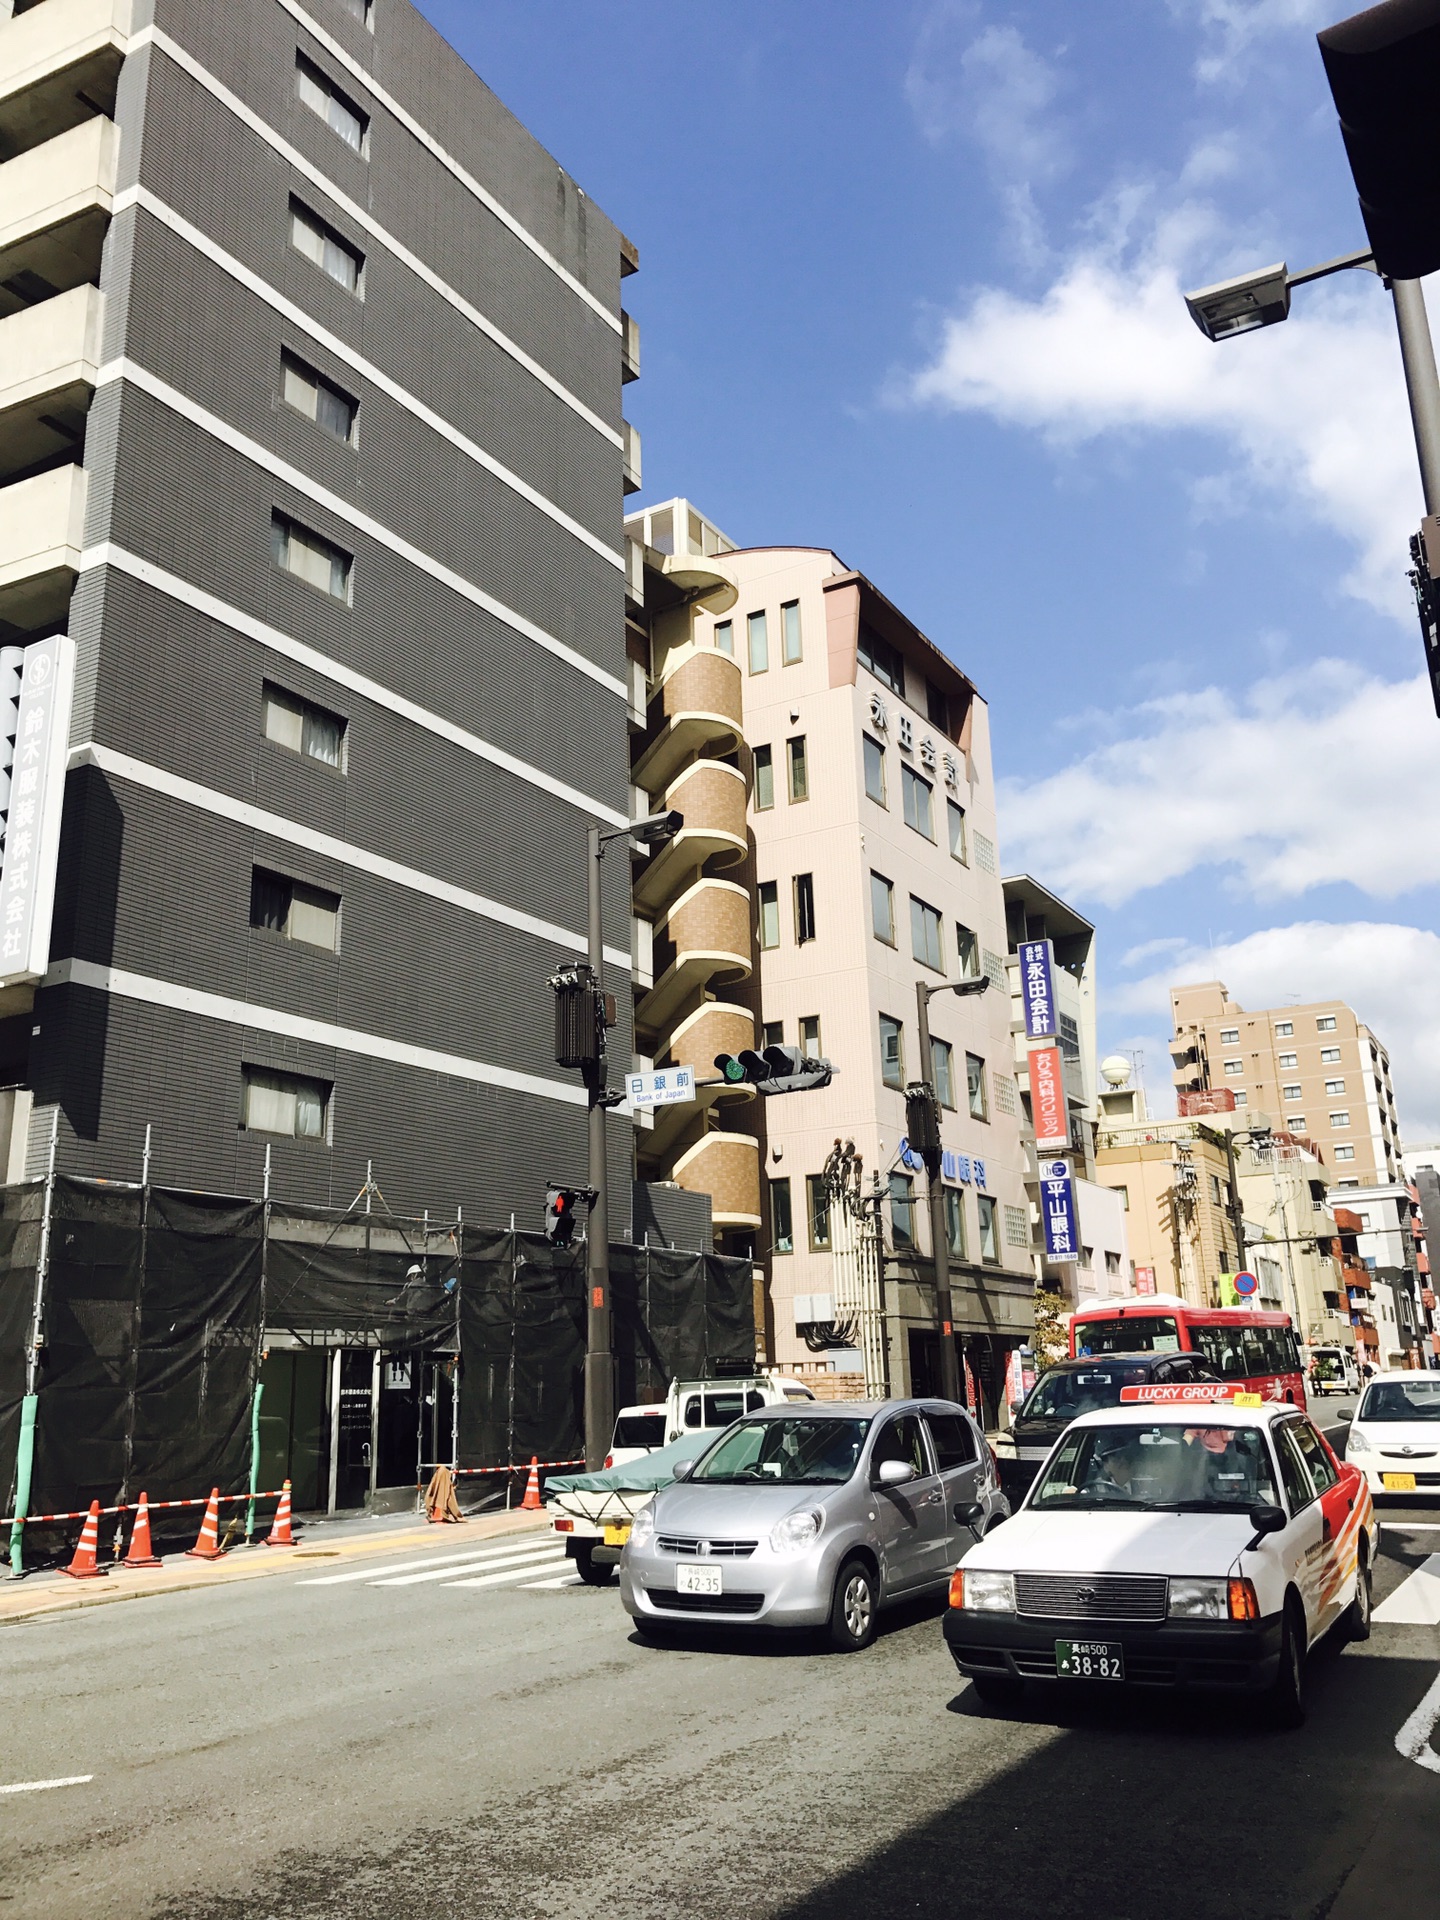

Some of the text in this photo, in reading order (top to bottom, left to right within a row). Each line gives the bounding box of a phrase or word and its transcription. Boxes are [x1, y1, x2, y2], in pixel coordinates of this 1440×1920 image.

[4, 705, 45, 958] 鈴木服装株式会社
[1027, 962, 1050, 1034] 永田会計
[631, 1072, 689, 1093] 日銀前
[636, 1093, 653, 1103] Bank
[665, 1090, 686, 1099] Japan
[1036, 1053, 1058, 1136] ちひろ内科クリニック
[1047, 1181, 1071, 1253] 平山眼科
[1137, 1386, 1229, 1399] LUCKY GROUP
[687, 1577, 720, 1592] 42-35
[1071, 1656, 1121, 1677] 38-82
